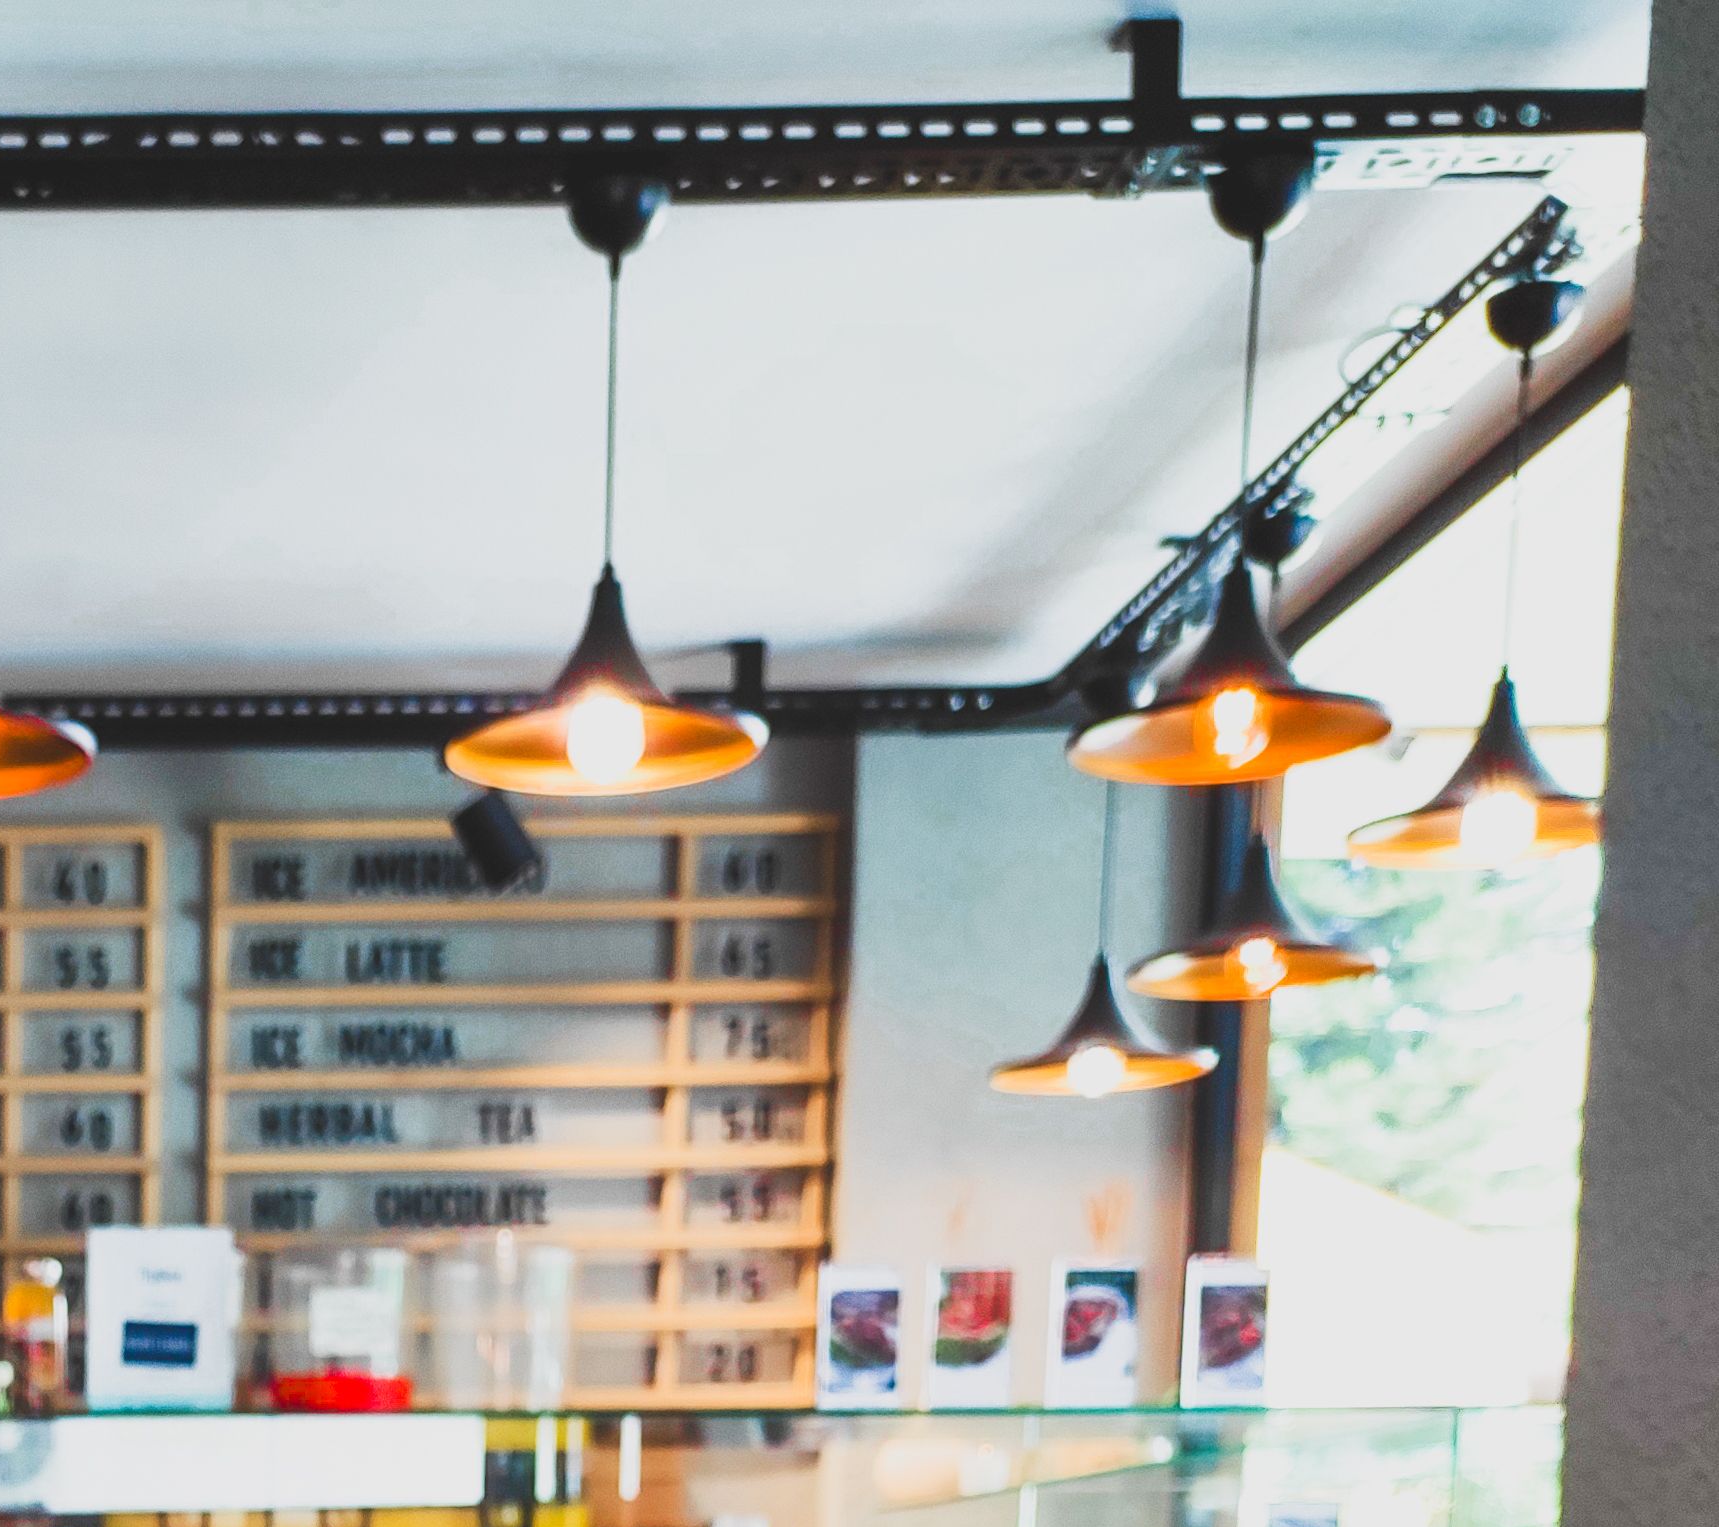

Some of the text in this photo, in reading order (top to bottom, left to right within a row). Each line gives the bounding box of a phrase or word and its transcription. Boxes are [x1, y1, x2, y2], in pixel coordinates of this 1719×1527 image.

[252, 855, 303, 900] ICE
[249, 939, 300, 980] ICE
[345, 941, 446, 984] LATTE
[251, 1025, 300, 1069] ICE
[339, 1022, 455, 1066] MOCHA
[259, 1103, 397, 1145] HERBAL
[478, 1103, 535, 1144] TEA
[251, 1188, 317, 1230] HOT
[375, 1182, 548, 1227] CHOCOLATE
